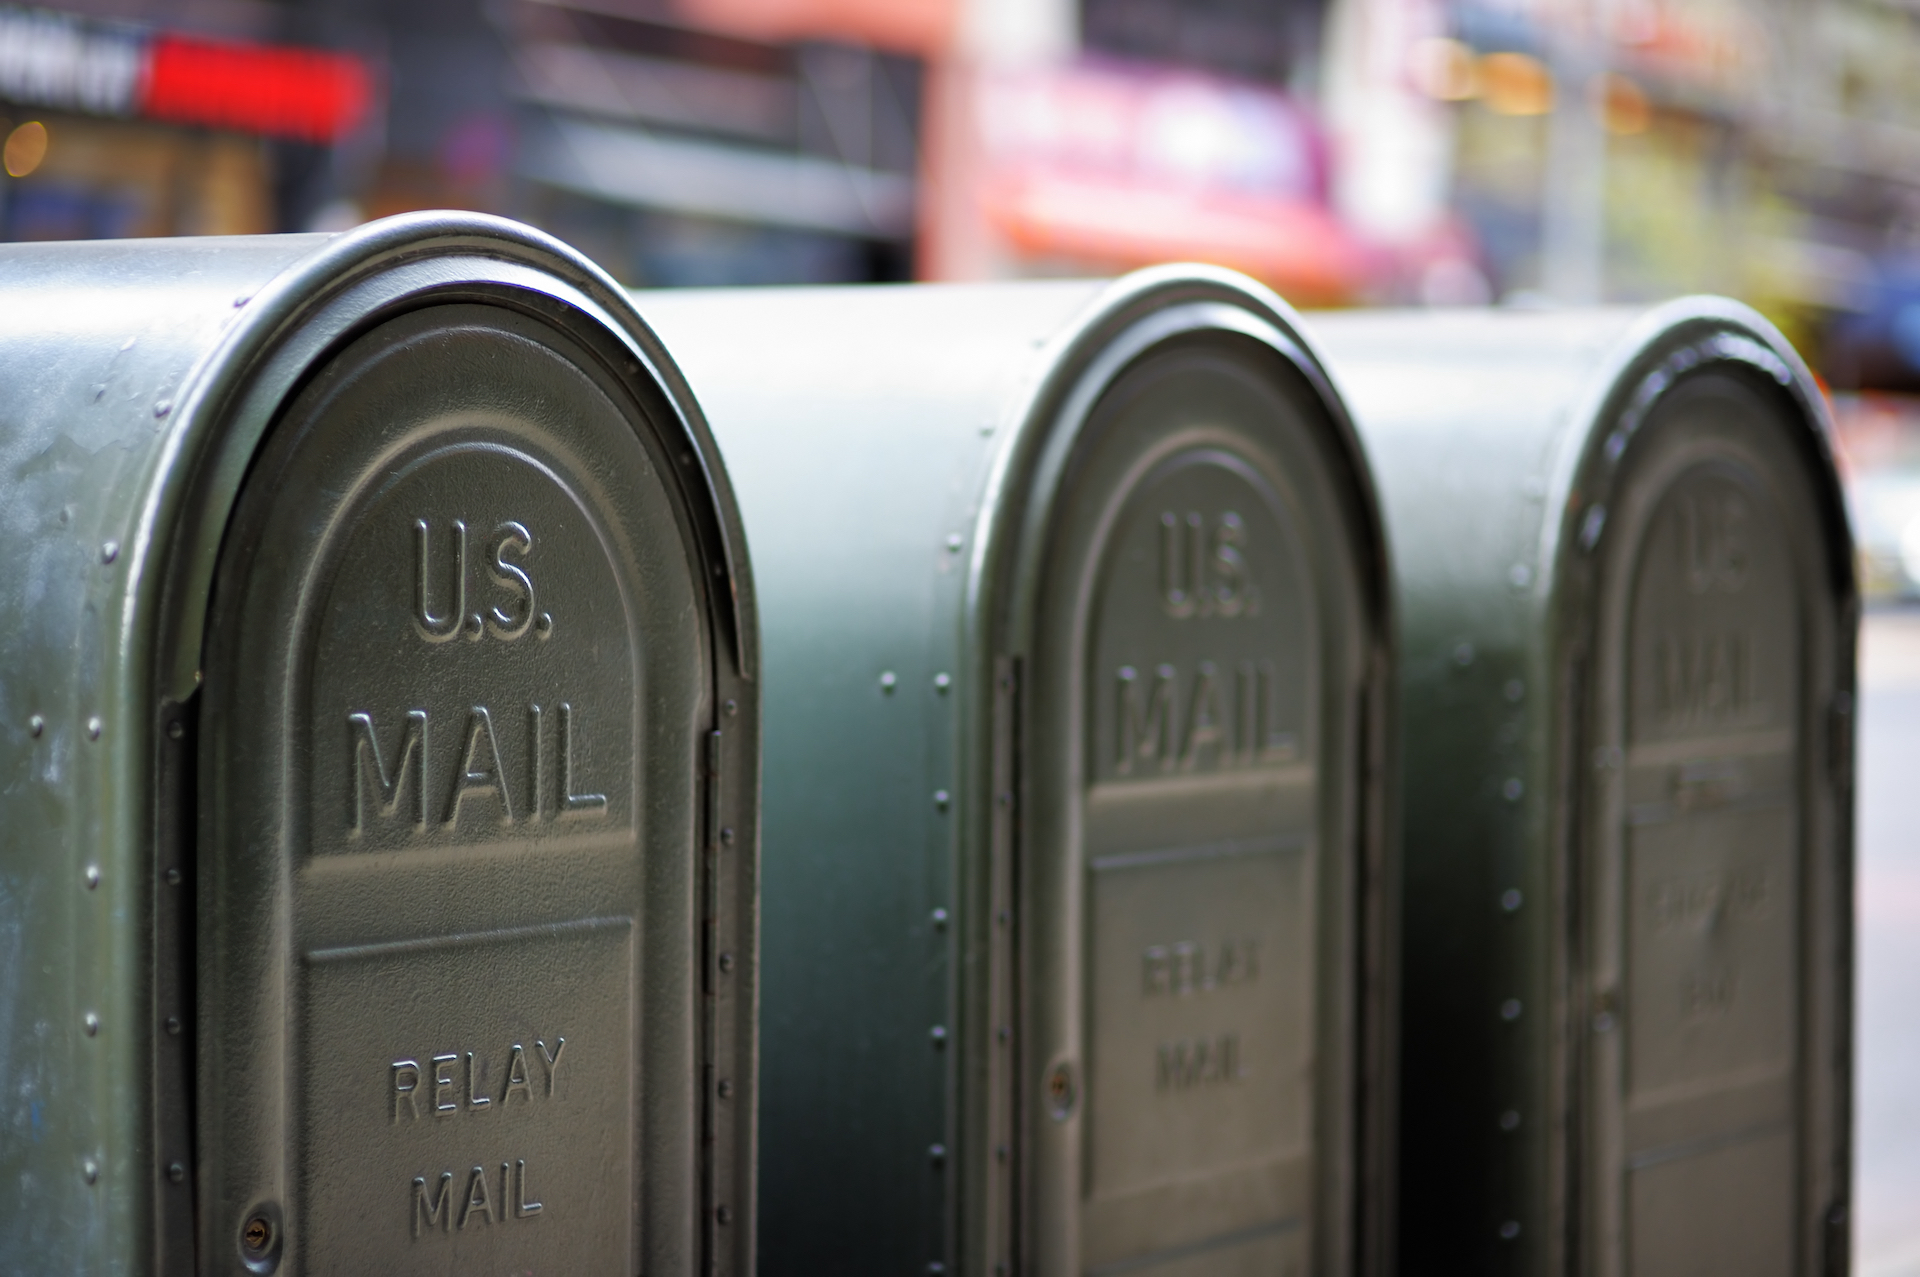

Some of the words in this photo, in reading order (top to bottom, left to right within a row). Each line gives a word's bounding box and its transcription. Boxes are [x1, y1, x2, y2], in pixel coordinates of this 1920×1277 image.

[412, 517, 553, 644] U.S.
[347, 701, 608, 841] MAIL
[1113, 659, 1297, 776] MAIL
[387, 1036, 566, 1126] RELAY
[410, 1159, 544, 1238] MAIL
